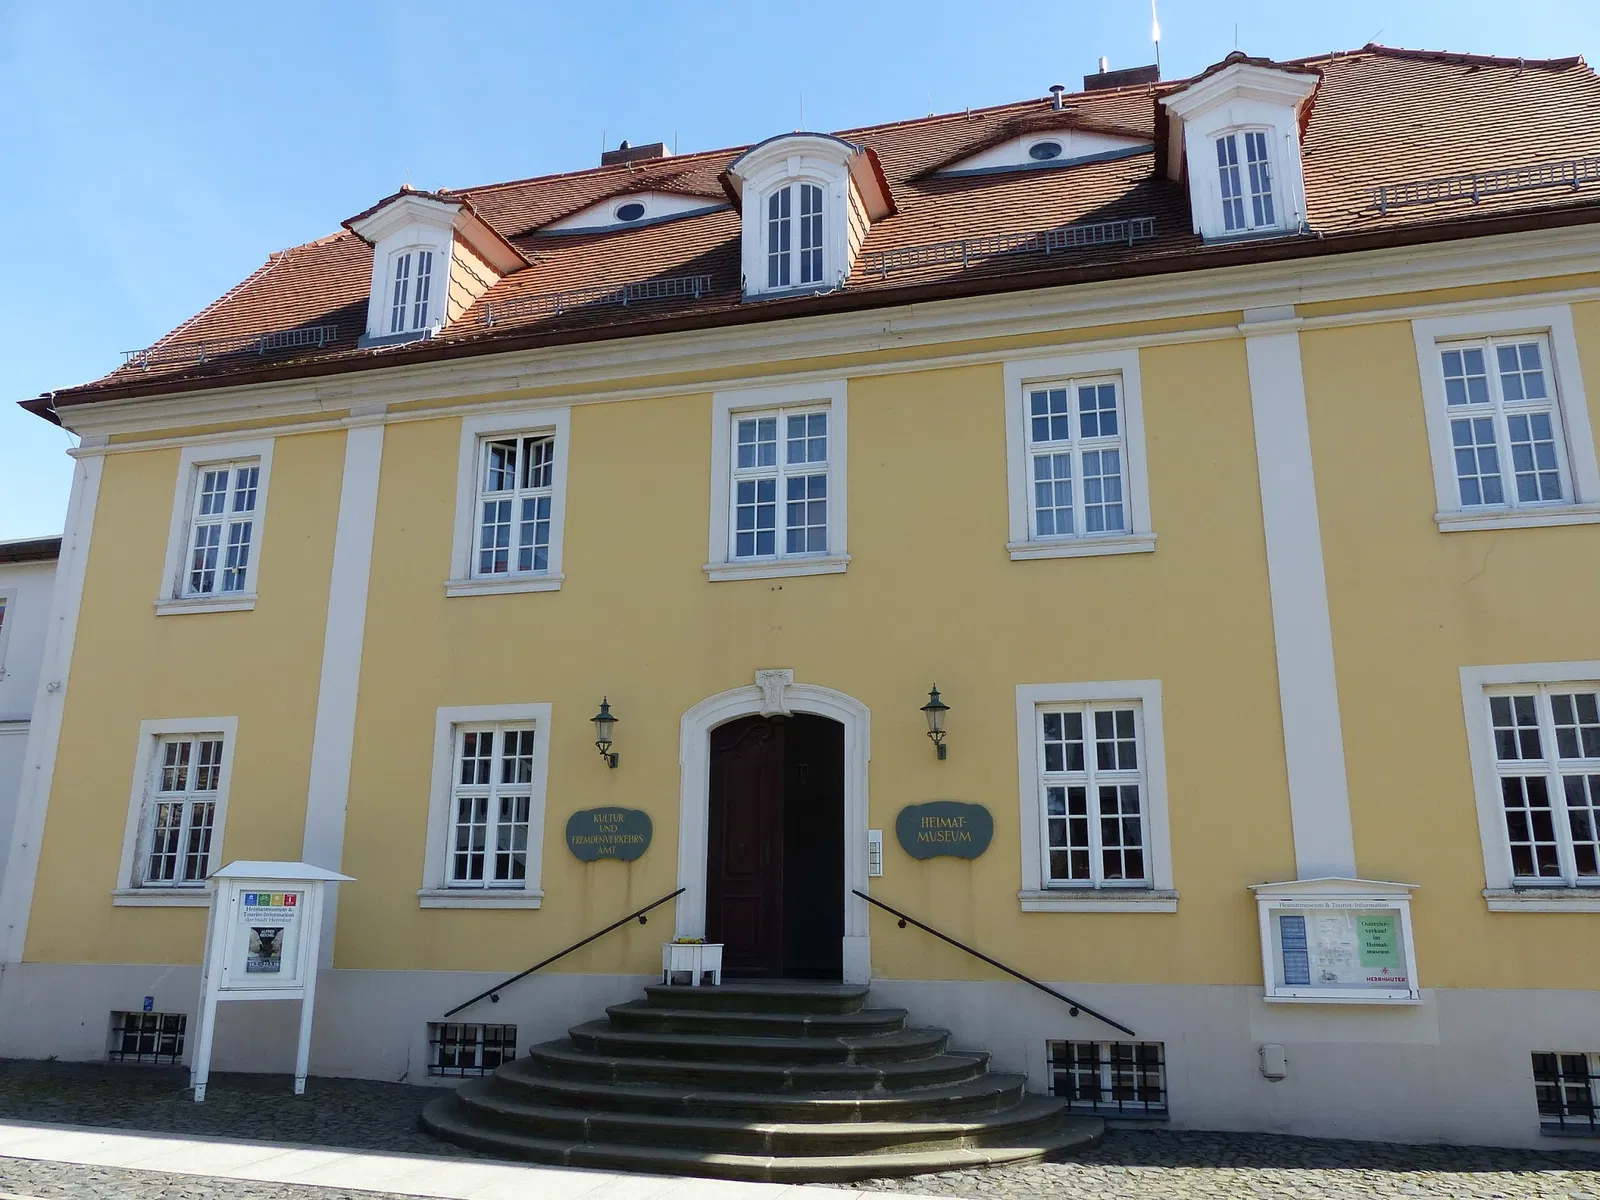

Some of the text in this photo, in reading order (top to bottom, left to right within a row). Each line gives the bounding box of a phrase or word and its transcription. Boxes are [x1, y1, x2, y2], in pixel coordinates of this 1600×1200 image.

[593, 813, 624, 823] KULTUR
[921, 816, 968, 828] HEIMAT-
[599, 824, 618, 832] UND
[571, 834, 644, 844] FREMDENVERKEHRS
[917, 830, 972, 842] MUSEUM
[597, 845, 617, 855] AMT
